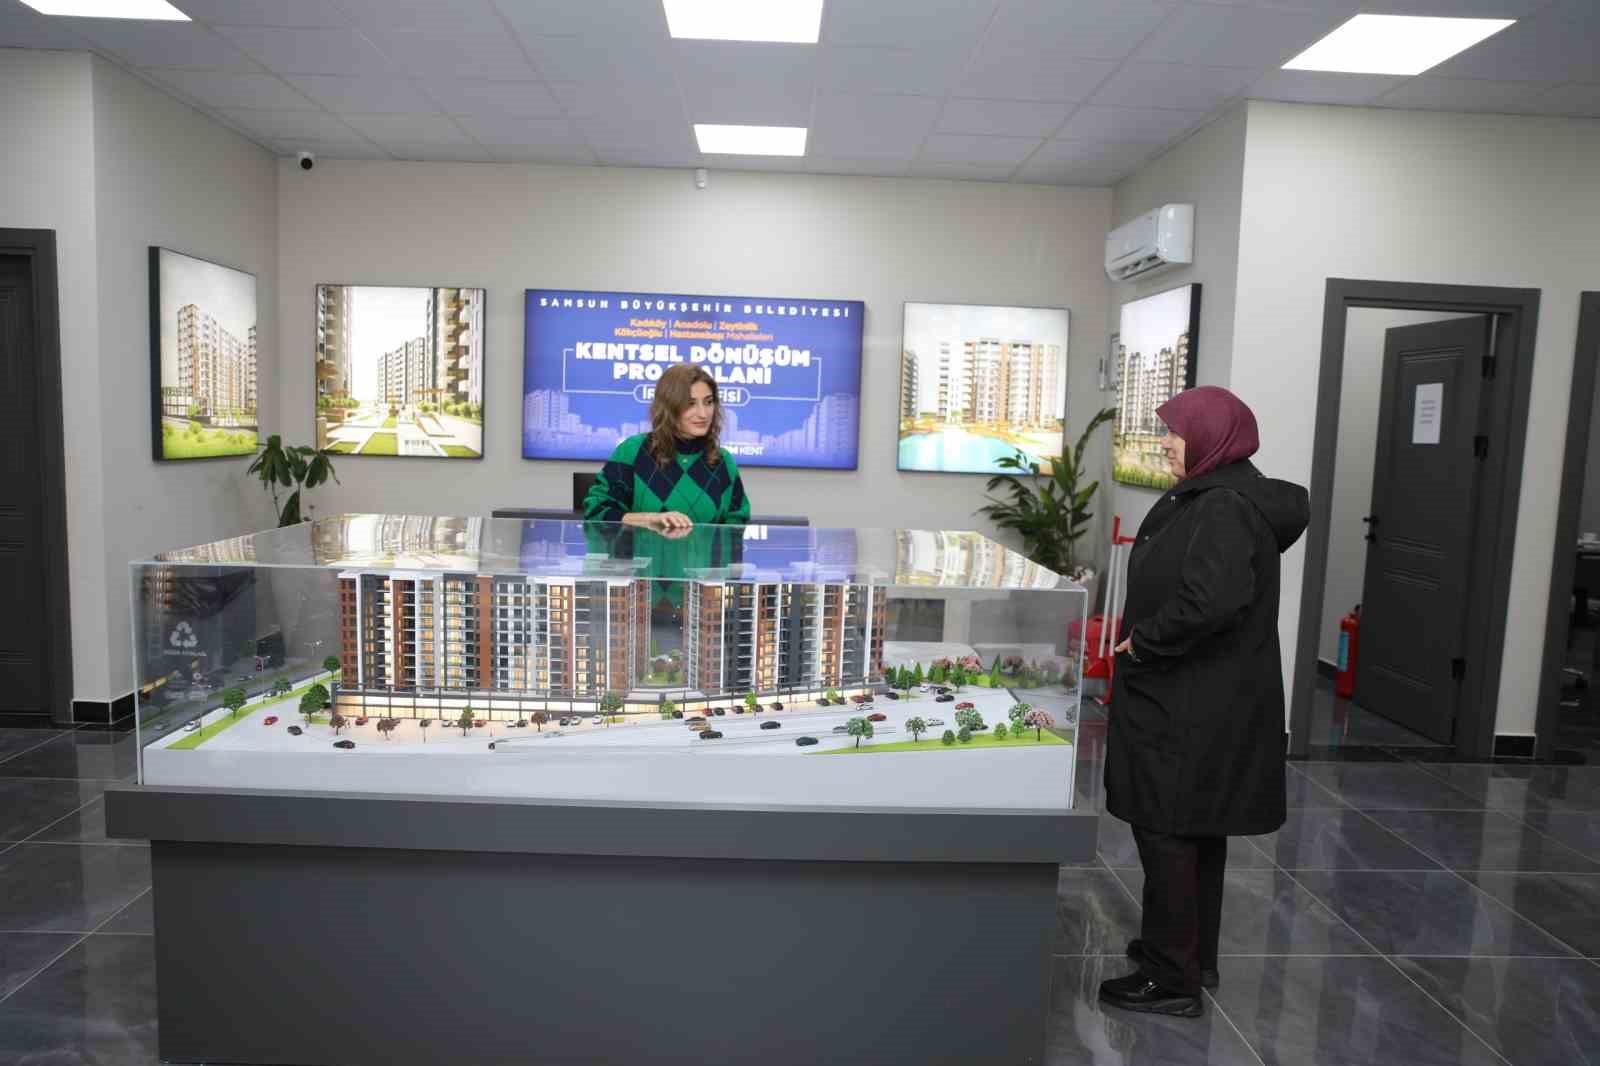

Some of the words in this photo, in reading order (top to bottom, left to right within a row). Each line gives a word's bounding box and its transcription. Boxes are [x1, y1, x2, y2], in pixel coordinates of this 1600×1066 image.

[540, 298, 608, 309] SAMSUN
[620, 299, 732, 313] BÜYÜKŞEHİR
[743, 304, 849, 318] BELEDİYESİ
[575, 341, 684, 363] KENTSEL
[690, 342, 811, 370] DÖNÜŞÜM
[613, 362, 667, 380] PRO
